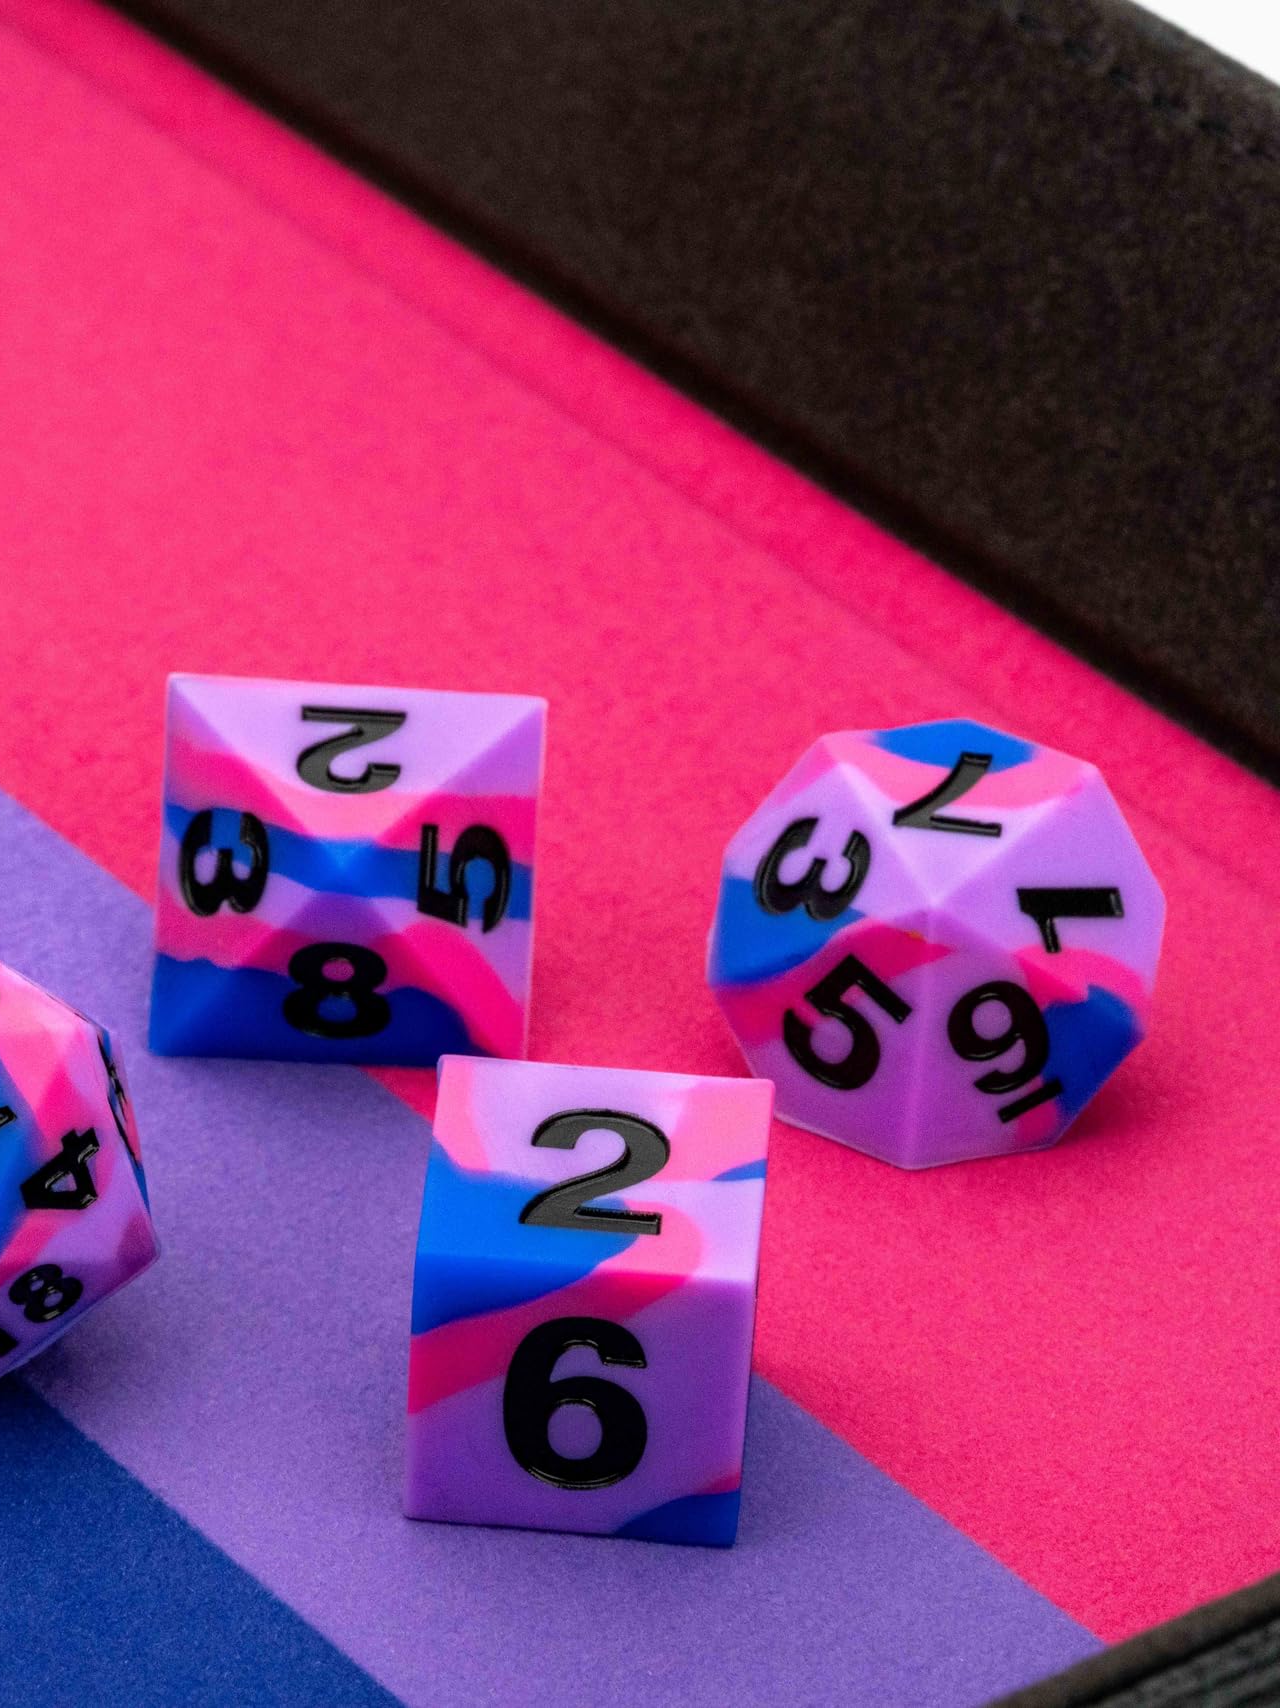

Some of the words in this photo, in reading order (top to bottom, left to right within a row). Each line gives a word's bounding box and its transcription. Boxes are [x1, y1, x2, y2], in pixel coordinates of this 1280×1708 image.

[296, 705, 407, 795] 2
[892, 752, 1003, 838] 7
[178, 809, 270, 917] 3
[416, 824, 511, 934] 5
[754, 817, 871, 920] 3
[1017, 887, 1124, 953] 1
[283, 942, 391, 1039] 8
[783, 954, 913, 1090] 5
[21, 1127, 101, 1211] 4
[519, 1108, 671, 1236] 2
[503, 1316, 648, 1490] 6
